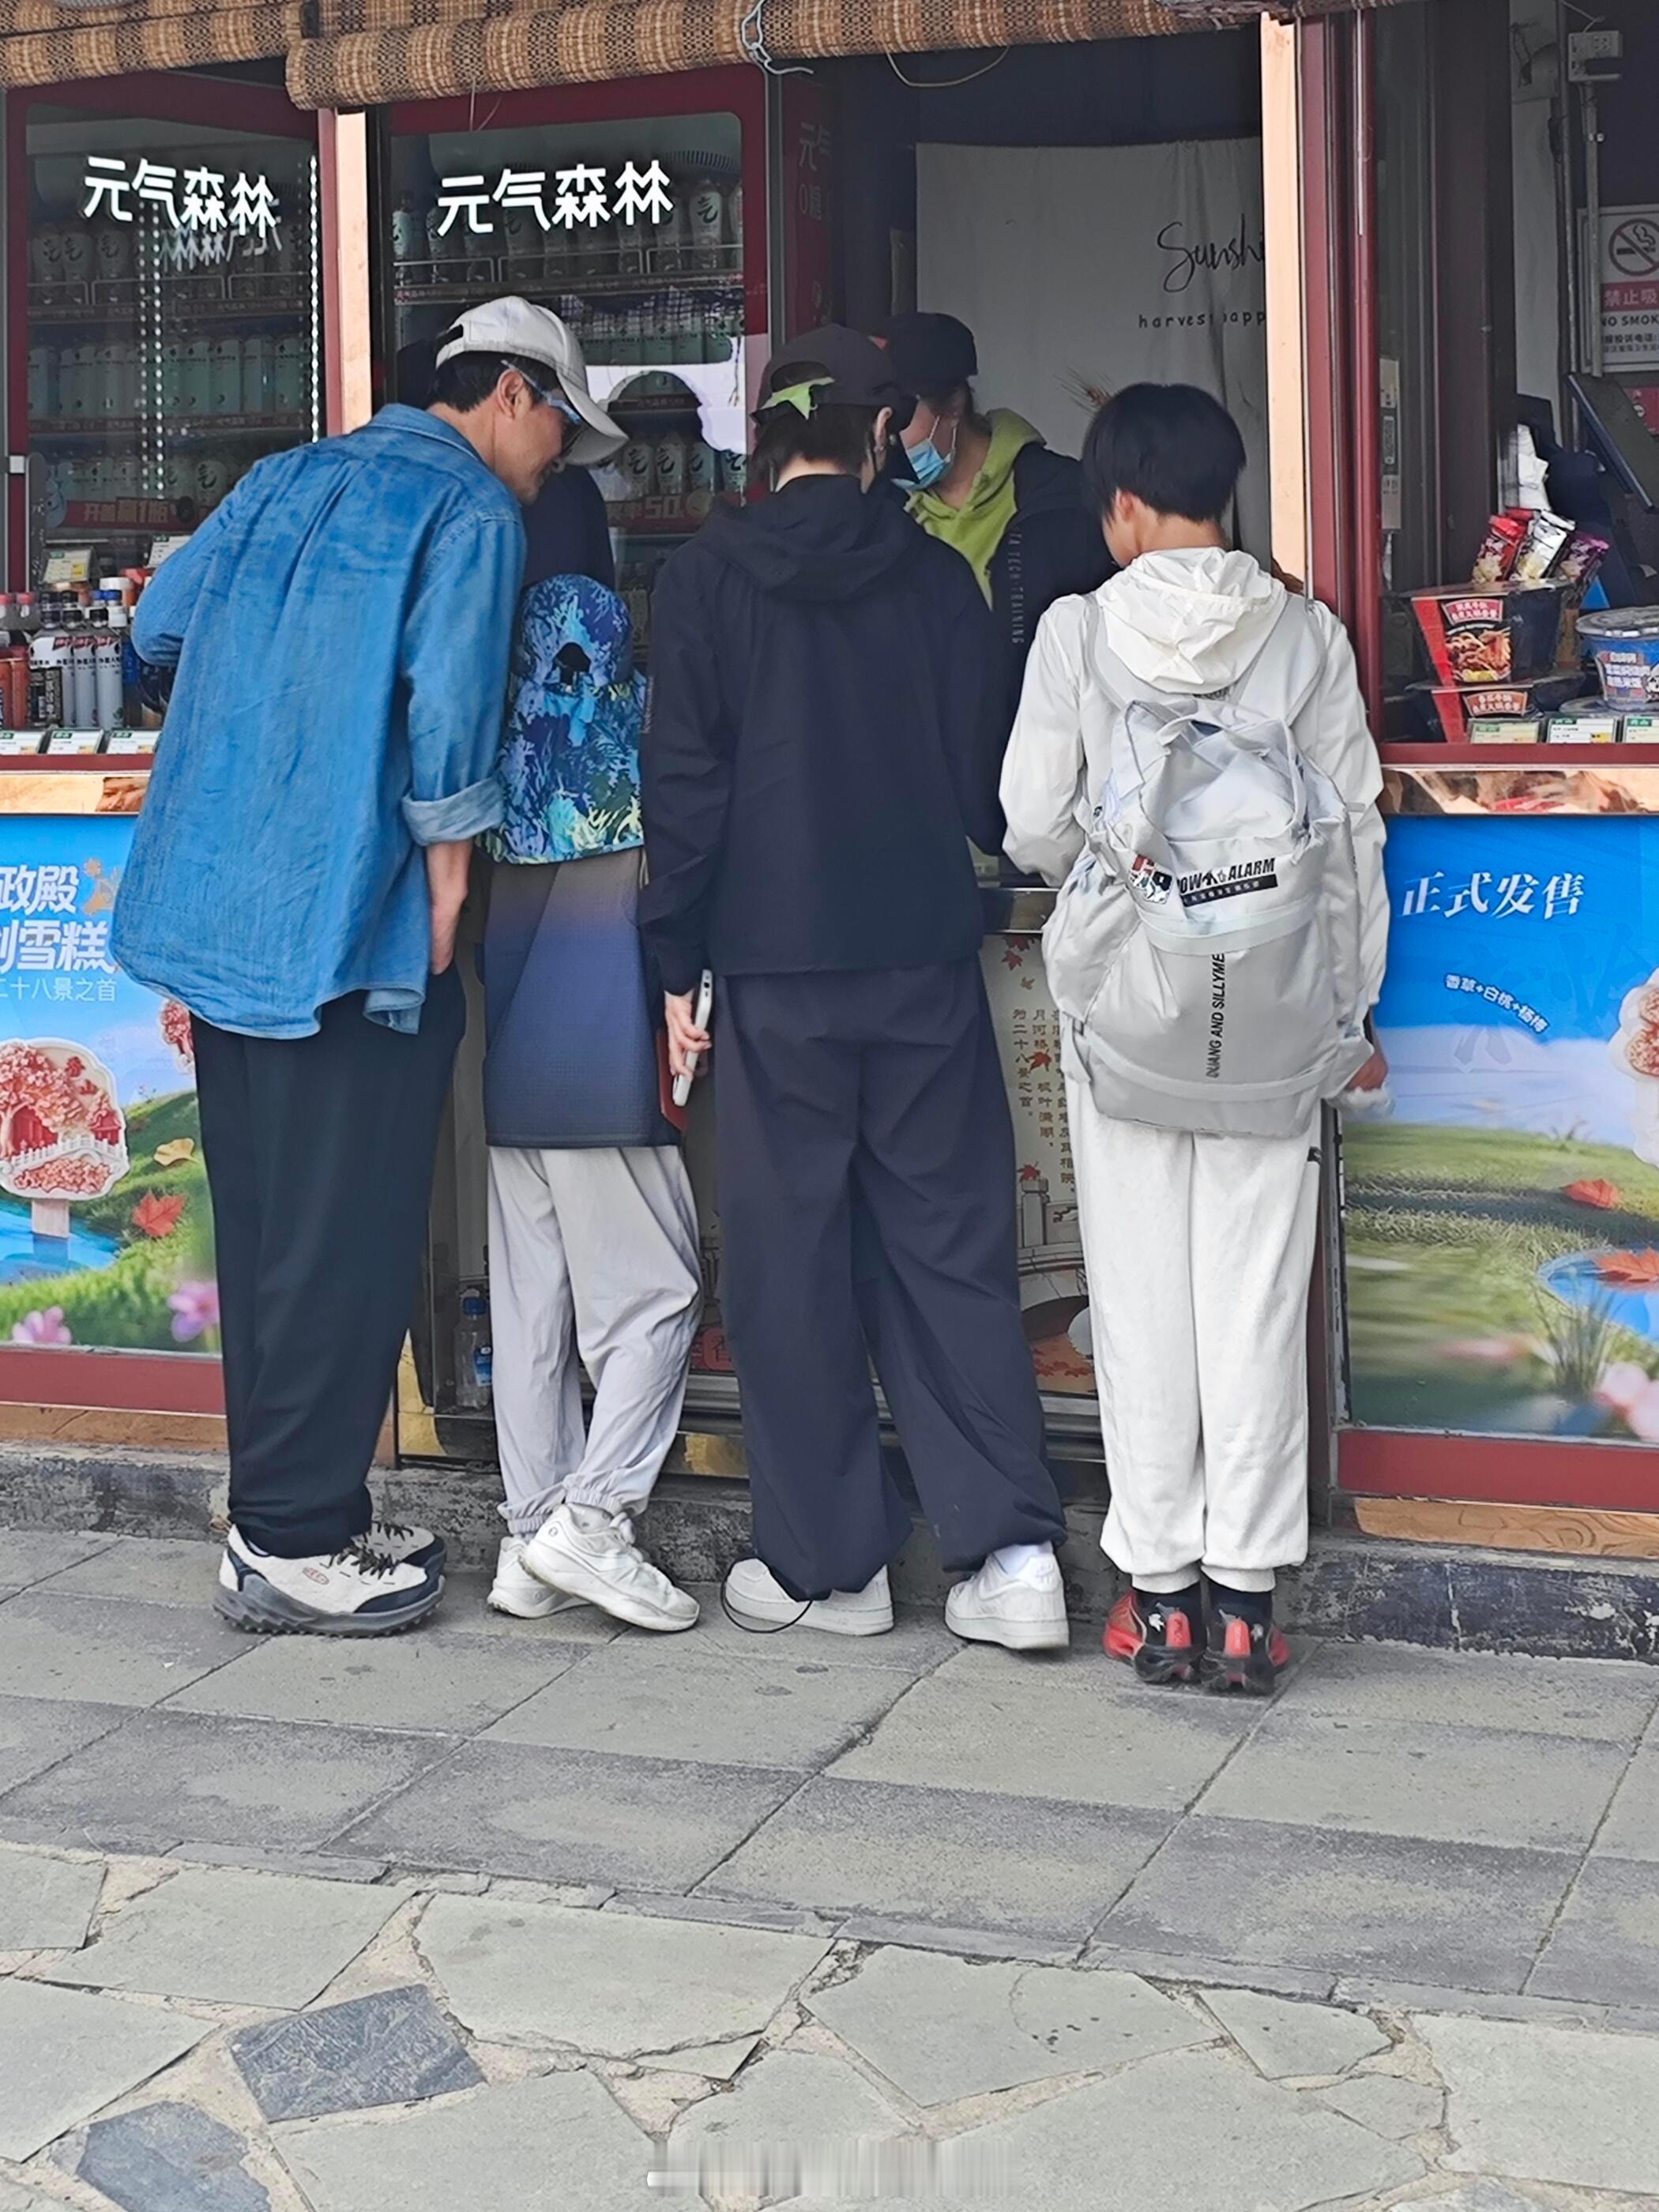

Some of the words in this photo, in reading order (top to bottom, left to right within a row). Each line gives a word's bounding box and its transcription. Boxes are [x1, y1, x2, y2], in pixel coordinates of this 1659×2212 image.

[84, 156, 278, 239] 元气森林
[437, 160, 673, 236] 元气森林
[1228, 857, 1276, 881] ALARM
[1399, 871, 1586, 920] 正式发售
[1209, 1012, 1224, 1038] AND
